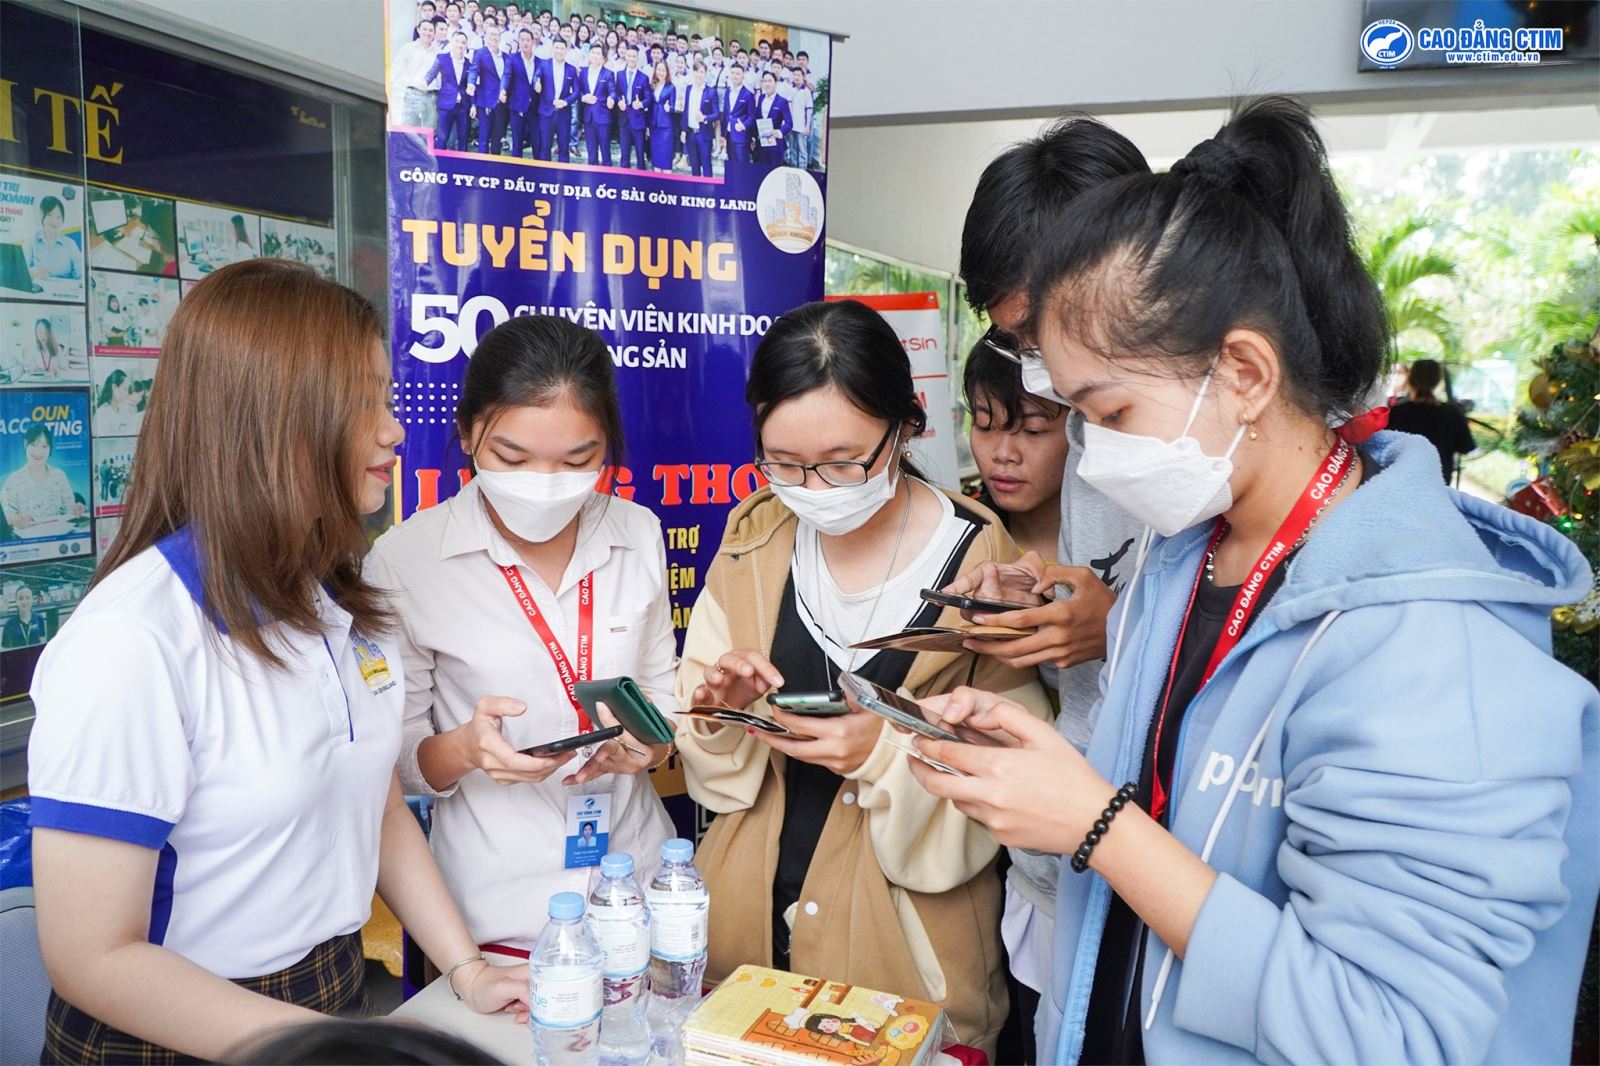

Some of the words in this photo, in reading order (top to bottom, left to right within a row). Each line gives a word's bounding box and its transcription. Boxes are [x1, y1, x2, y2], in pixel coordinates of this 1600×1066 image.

[34, 82, 123, 164] TẾ
[399, 167, 448, 184] CÔNG
[452, 174, 475, 187] TY
[478, 176, 500, 189] CP
[504, 176, 535, 193] ĐẦU
[539, 182, 561, 195] TƯ
[563, 185, 592, 200] ĐỊA
[595, 183, 617, 199] ỐC
[620, 187, 645, 202] SÀI
[648, 190, 677, 205] GÒN
[680, 196, 716, 209] KING
[720, 199, 757, 212] LAND
[402, 199, 586, 273] TUYỂN
[602, 233, 737, 290] DỤNG
[620, 303, 674, 333] VIÊN
[677, 312, 736, 335] KINH
[642, 339, 687, 369] SẢN
[1310, 473, 1333, 500] CAO
[666, 524, 700, 554] TRỢ
[581, 588, 589, 605] CAO
[1228, 609, 1245, 637] CAO
[1260, 541, 1286, 571] CTIM
[580, 635, 588, 655] CTIM
